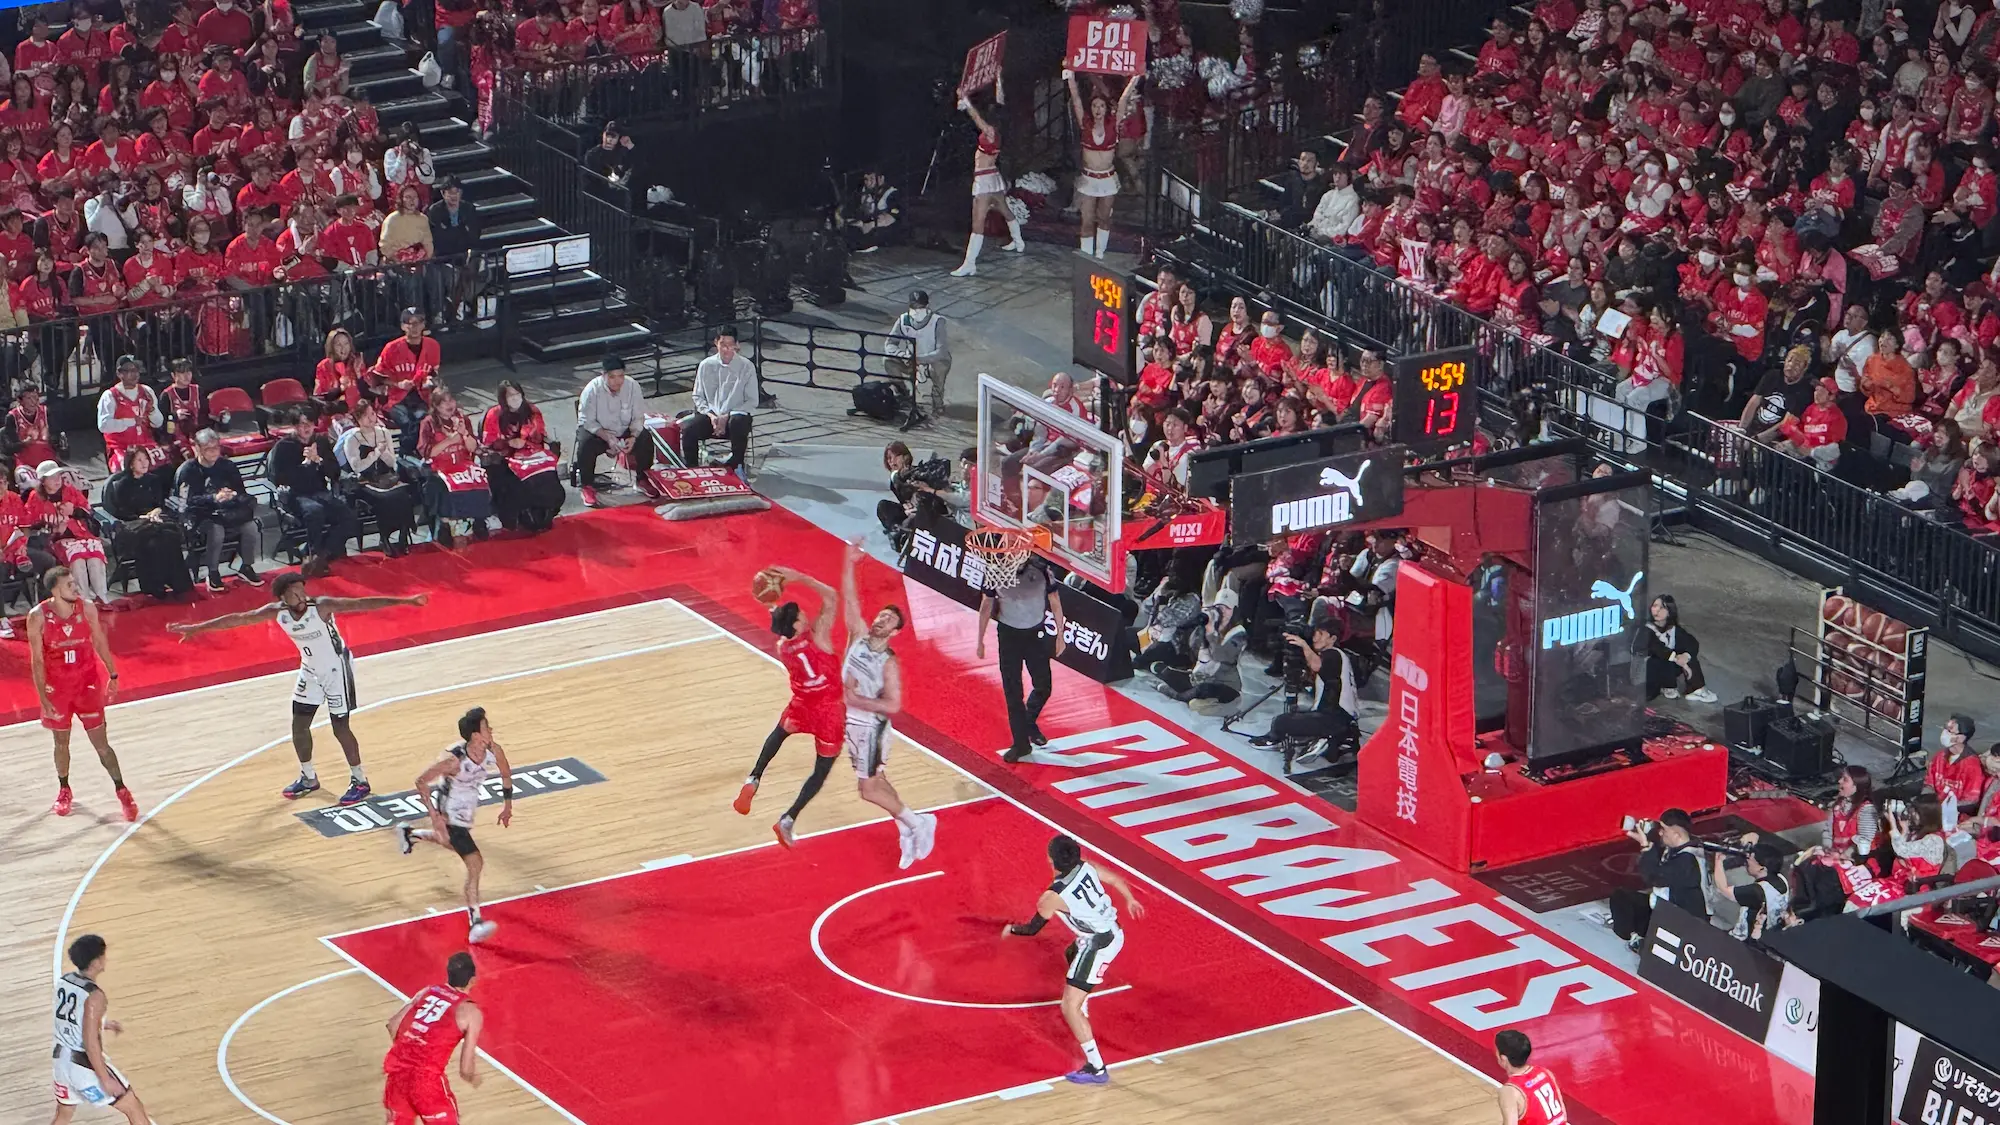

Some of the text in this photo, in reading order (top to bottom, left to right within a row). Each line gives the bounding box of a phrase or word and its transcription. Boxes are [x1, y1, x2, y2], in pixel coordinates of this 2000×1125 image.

[1087, 20, 1131, 49] GO!
[1073, 48, 1136, 72] JETS!!
[1090, 274, 1122, 309] 4:54
[1094, 309, 1119, 354] 13
[1421, 361, 1466, 391] 4:54
[1424, 391, 1459, 435] 13
[1169, 522, 1202, 538] MIXI
[1272, 491, 1350, 534] PUMA
[1542, 604, 1621, 650] PUMA
[64, 650, 76, 664] 10
[302, 646, 313, 657] 0
[797, 652, 817, 678] 1
[1396, 690, 1420, 825] 日本電技
[1072, 873, 1104, 909] 77
[1679, 943, 1765, 1013] SoftBank
[55, 987, 79, 1026] 22
[414, 995, 451, 1024] 33
[1533, 1082, 1562, 1121] 12
